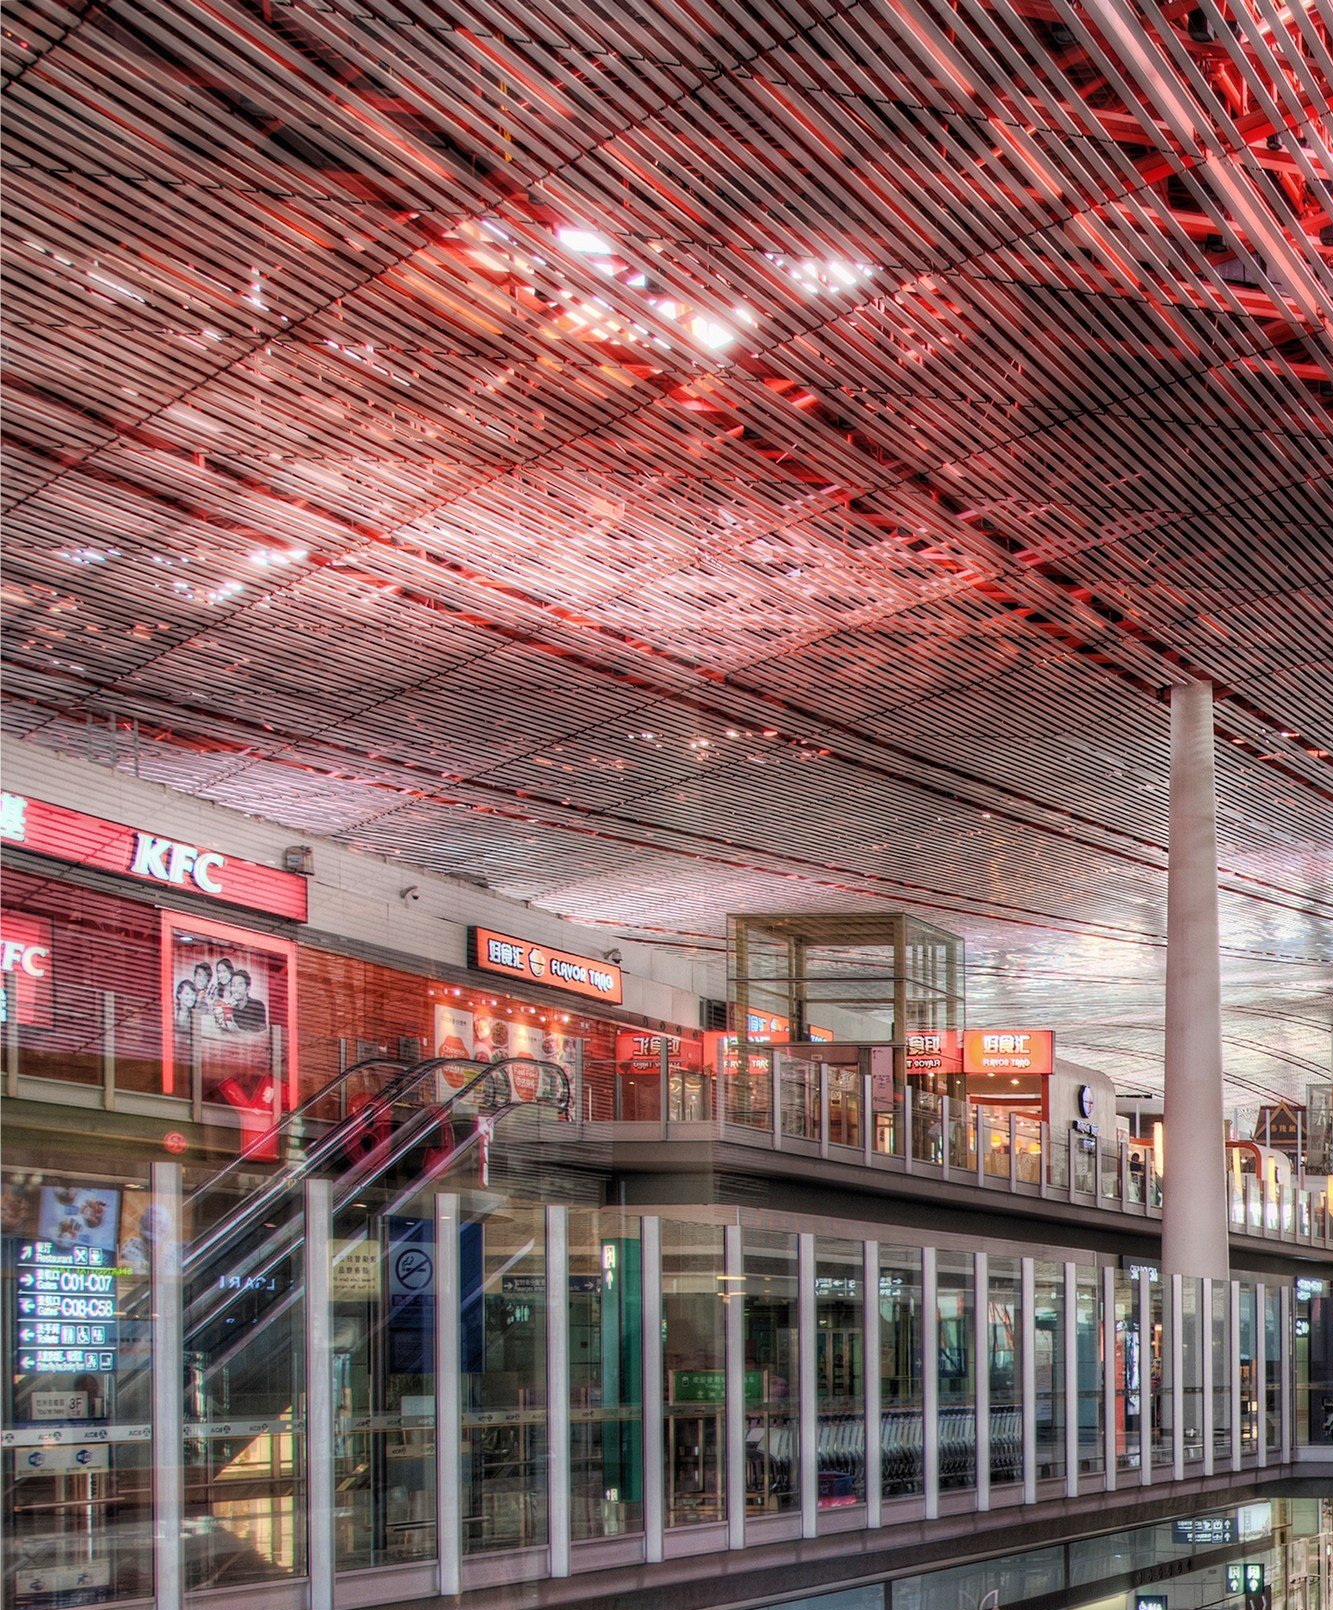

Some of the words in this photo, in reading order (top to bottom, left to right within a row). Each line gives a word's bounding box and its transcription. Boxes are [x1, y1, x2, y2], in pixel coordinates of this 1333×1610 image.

[131, 832, 224, 893] KFC
[0, 939, 49, 977] FC
[488, 938, 524, 970] 好食汇
[550, 958, 586, 982] FLAVOR
[588, 970, 614, 992] TANG
[983, 1034, 1031, 1055] 好食汇
[983, 1058, 1010, 1068] FLAVOR
[1011, 1058, 1031, 1069] TANG
[36, 1253, 73, 1264] Restaurant
[60, 1273, 113, 1291] C01-C07
[61, 1297, 114, 1317] C08-C58
[68, 1397, 82, 1410] 3F
